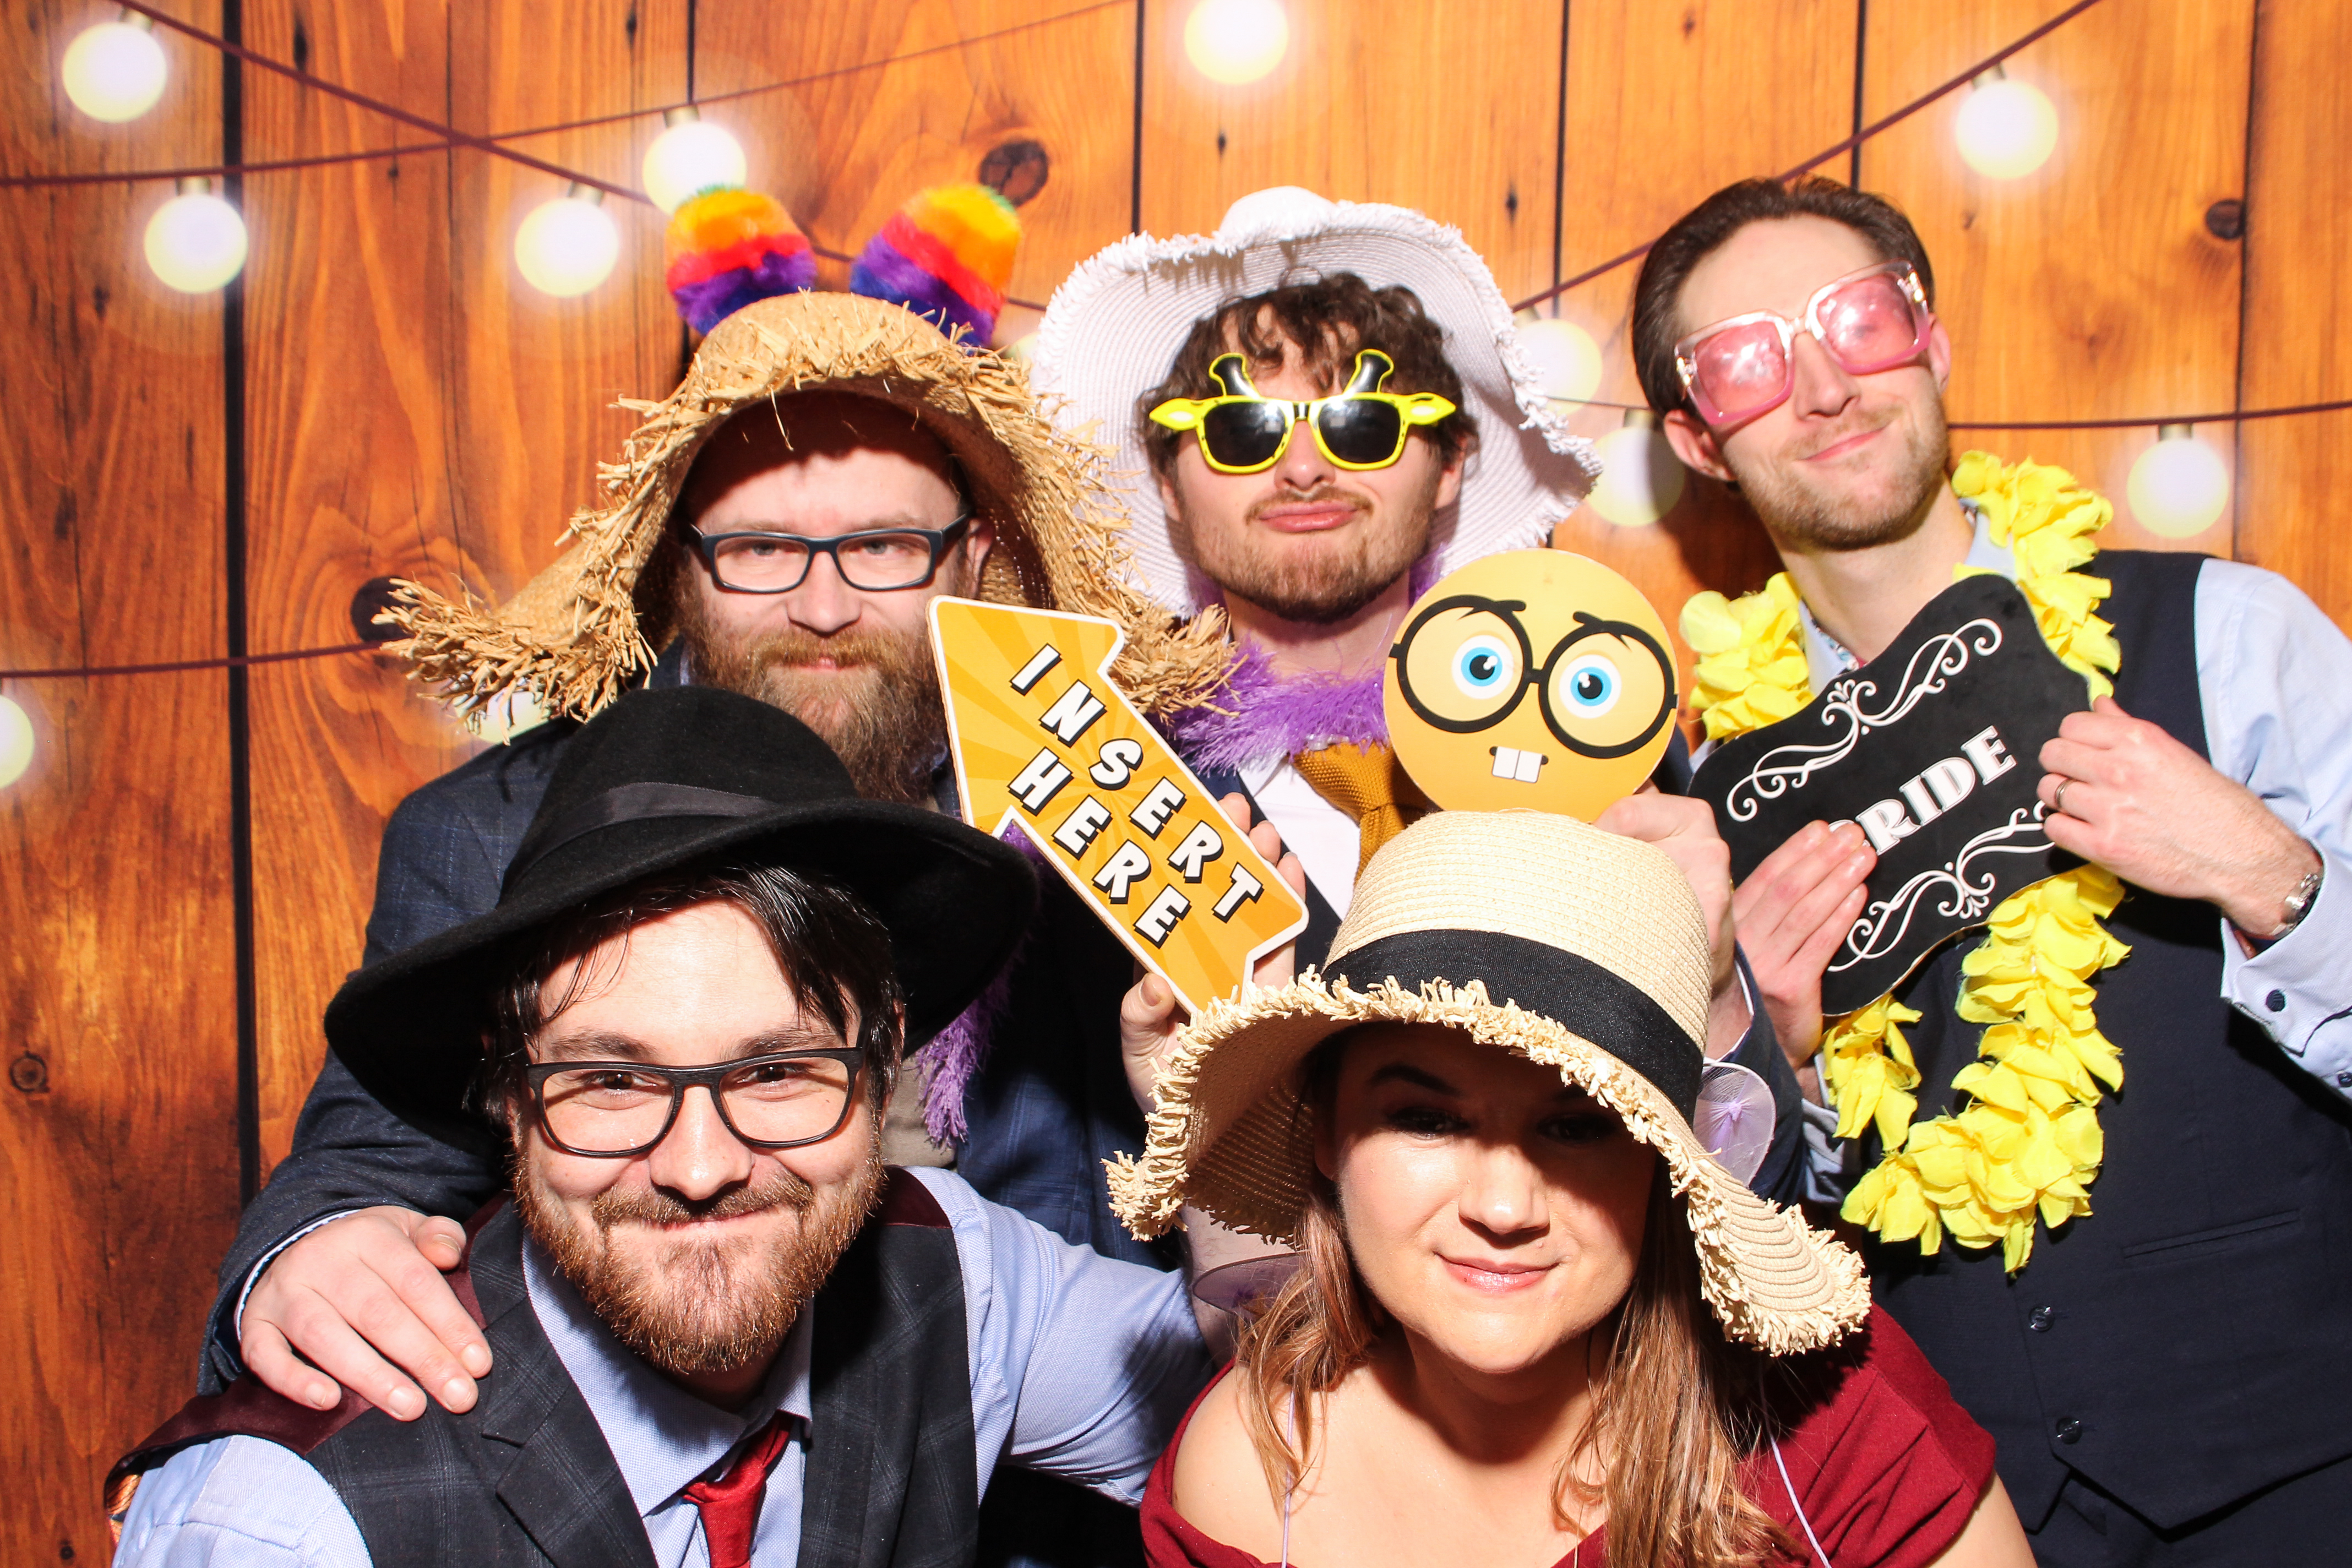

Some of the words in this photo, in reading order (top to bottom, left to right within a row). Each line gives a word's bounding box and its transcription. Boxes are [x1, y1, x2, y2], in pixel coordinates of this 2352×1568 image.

[1008, 747, 1190, 948] HERE
[1010, 643, 1263, 922] INSERT
[1828, 726, 2017, 856] RIDE
